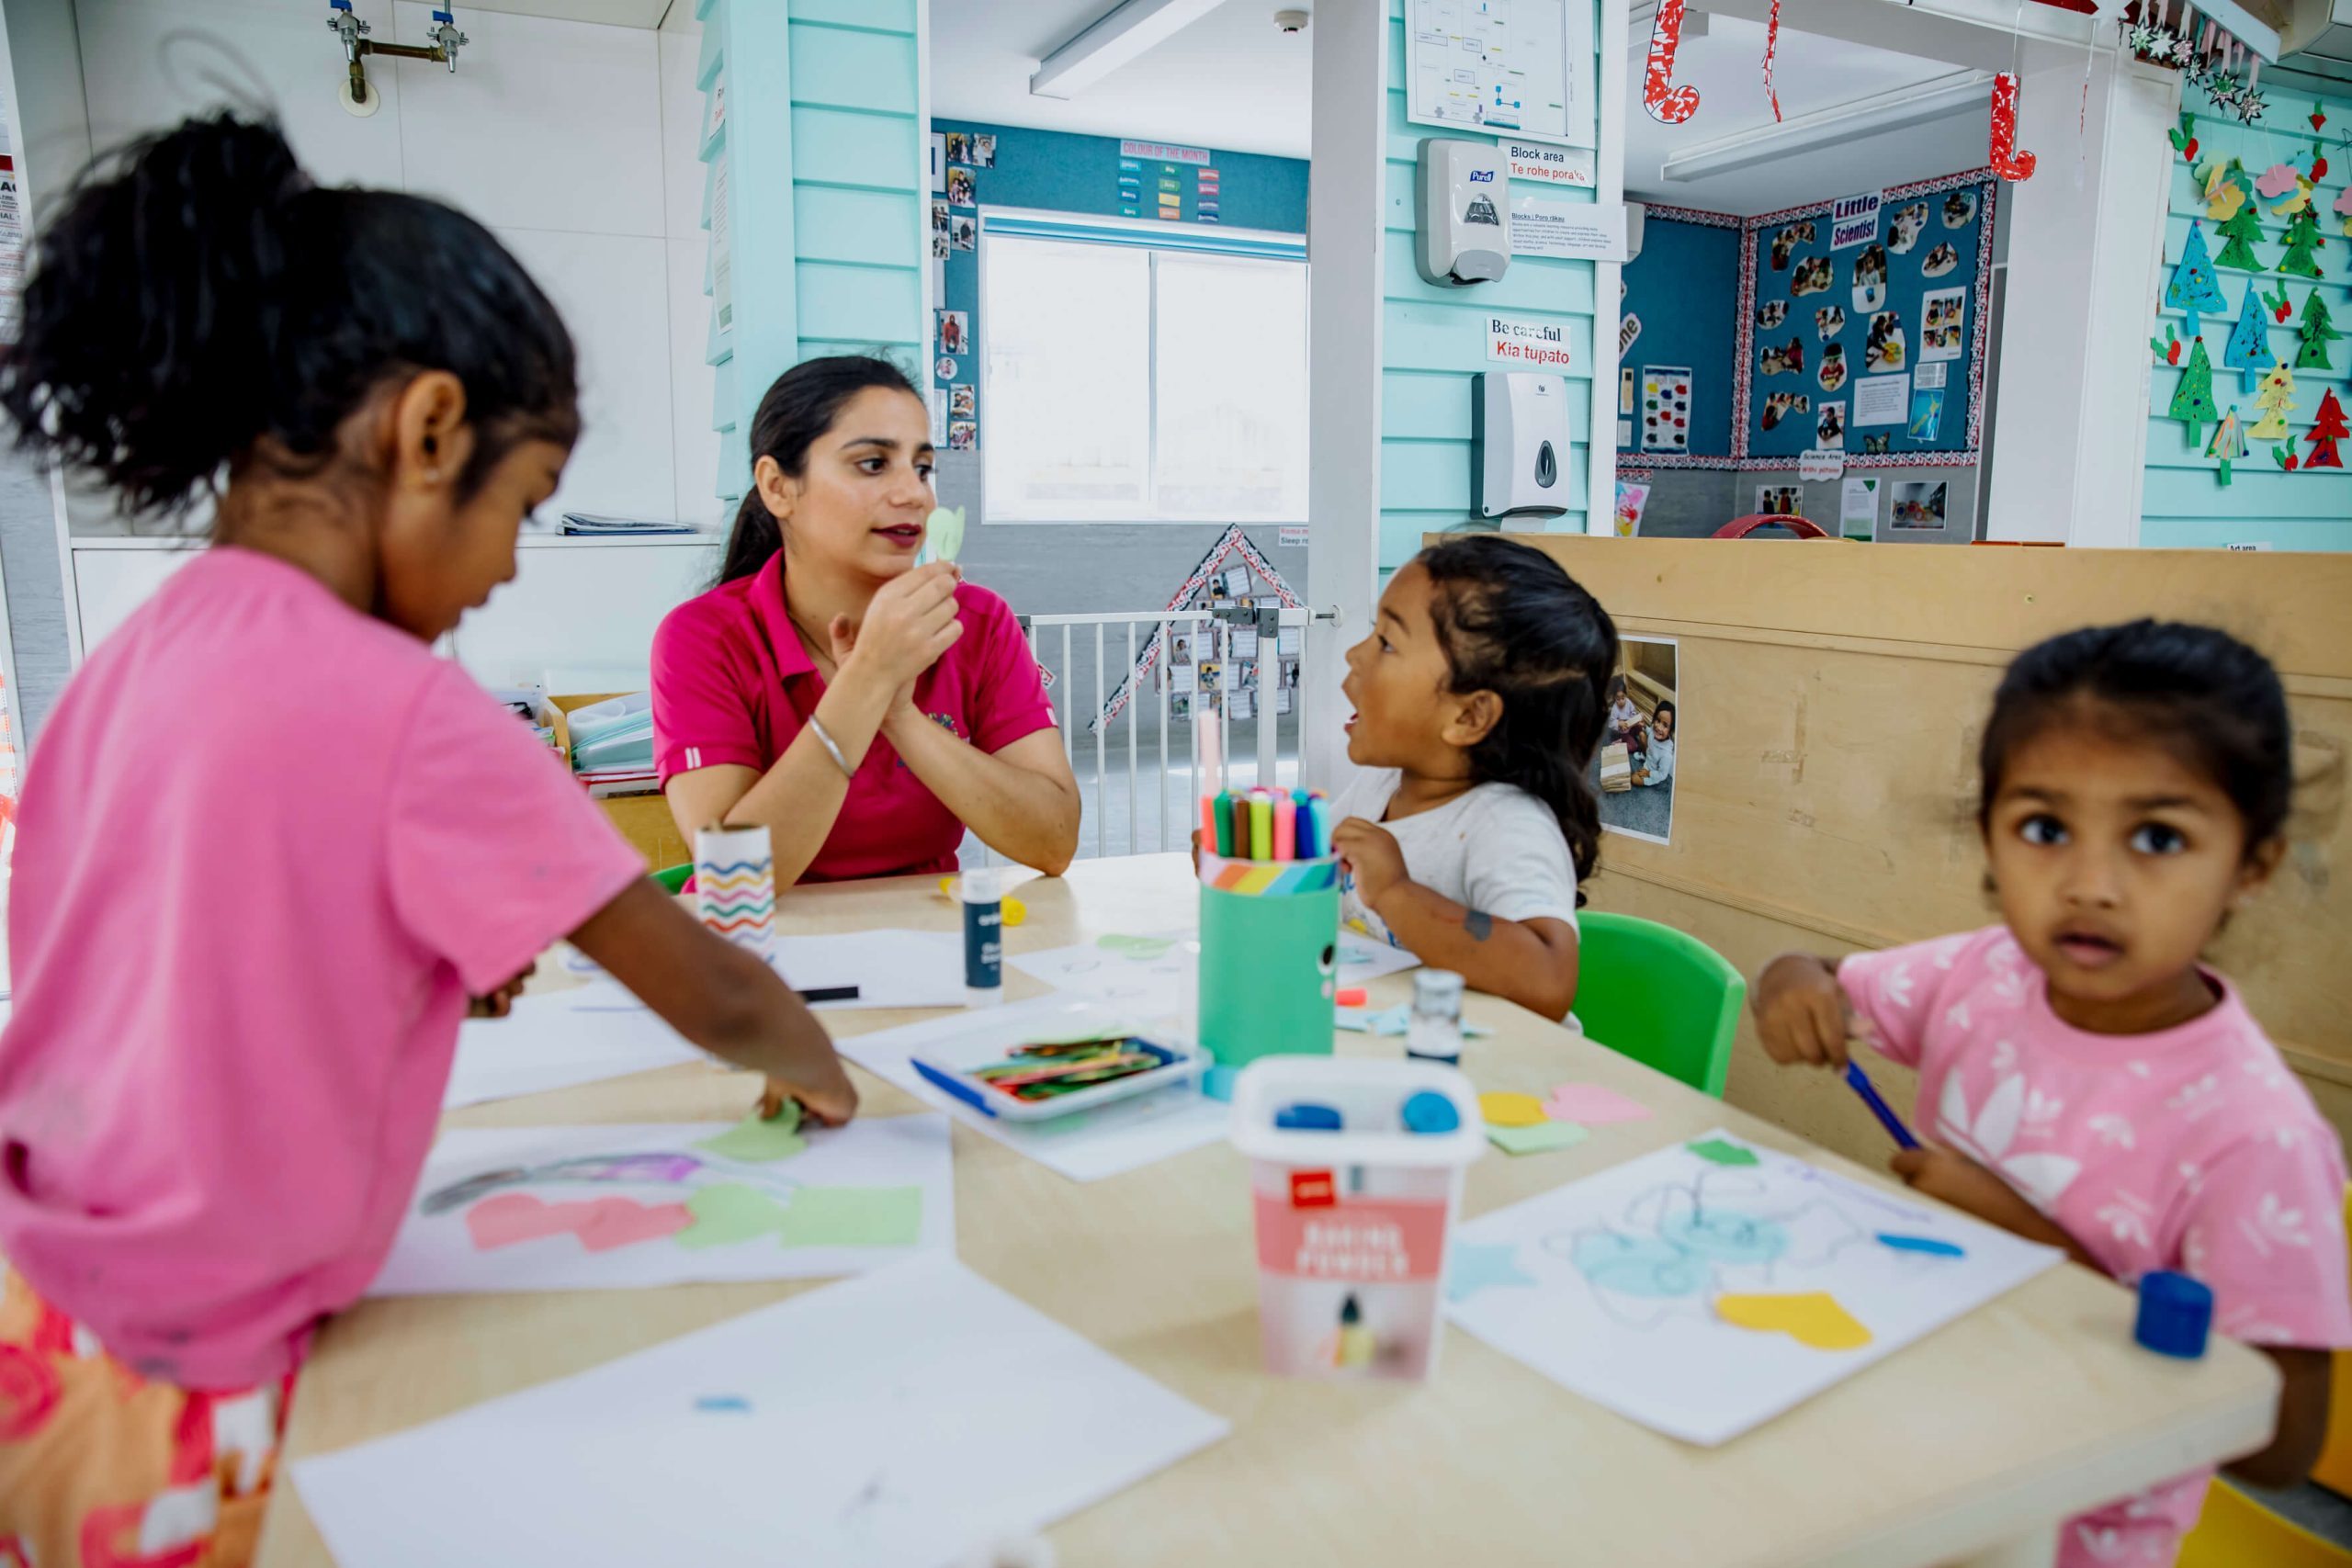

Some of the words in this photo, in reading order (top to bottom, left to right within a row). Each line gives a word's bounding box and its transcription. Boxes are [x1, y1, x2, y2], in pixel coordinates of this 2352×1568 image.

[1123, 141, 1153, 155] COLOUR
[1154, 145, 1163, 157] OF
[1166, 147, 1180, 160] THE
[1182, 149, 1208, 163] MONTH
[1510, 146, 1540, 160] Block
[1544, 152, 1564, 163] area
[1510, 163, 1523, 175] Te
[1527, 165, 1550, 177] rohe
[1835, 195, 1879, 219] Little
[1834, 218, 1876, 246] Scientist
[1492, 319, 1510, 334] Be
[1513, 325, 1561, 342] careful
[1497, 340, 1520, 357] Kia
[1524, 344, 1569, 365] tupato
